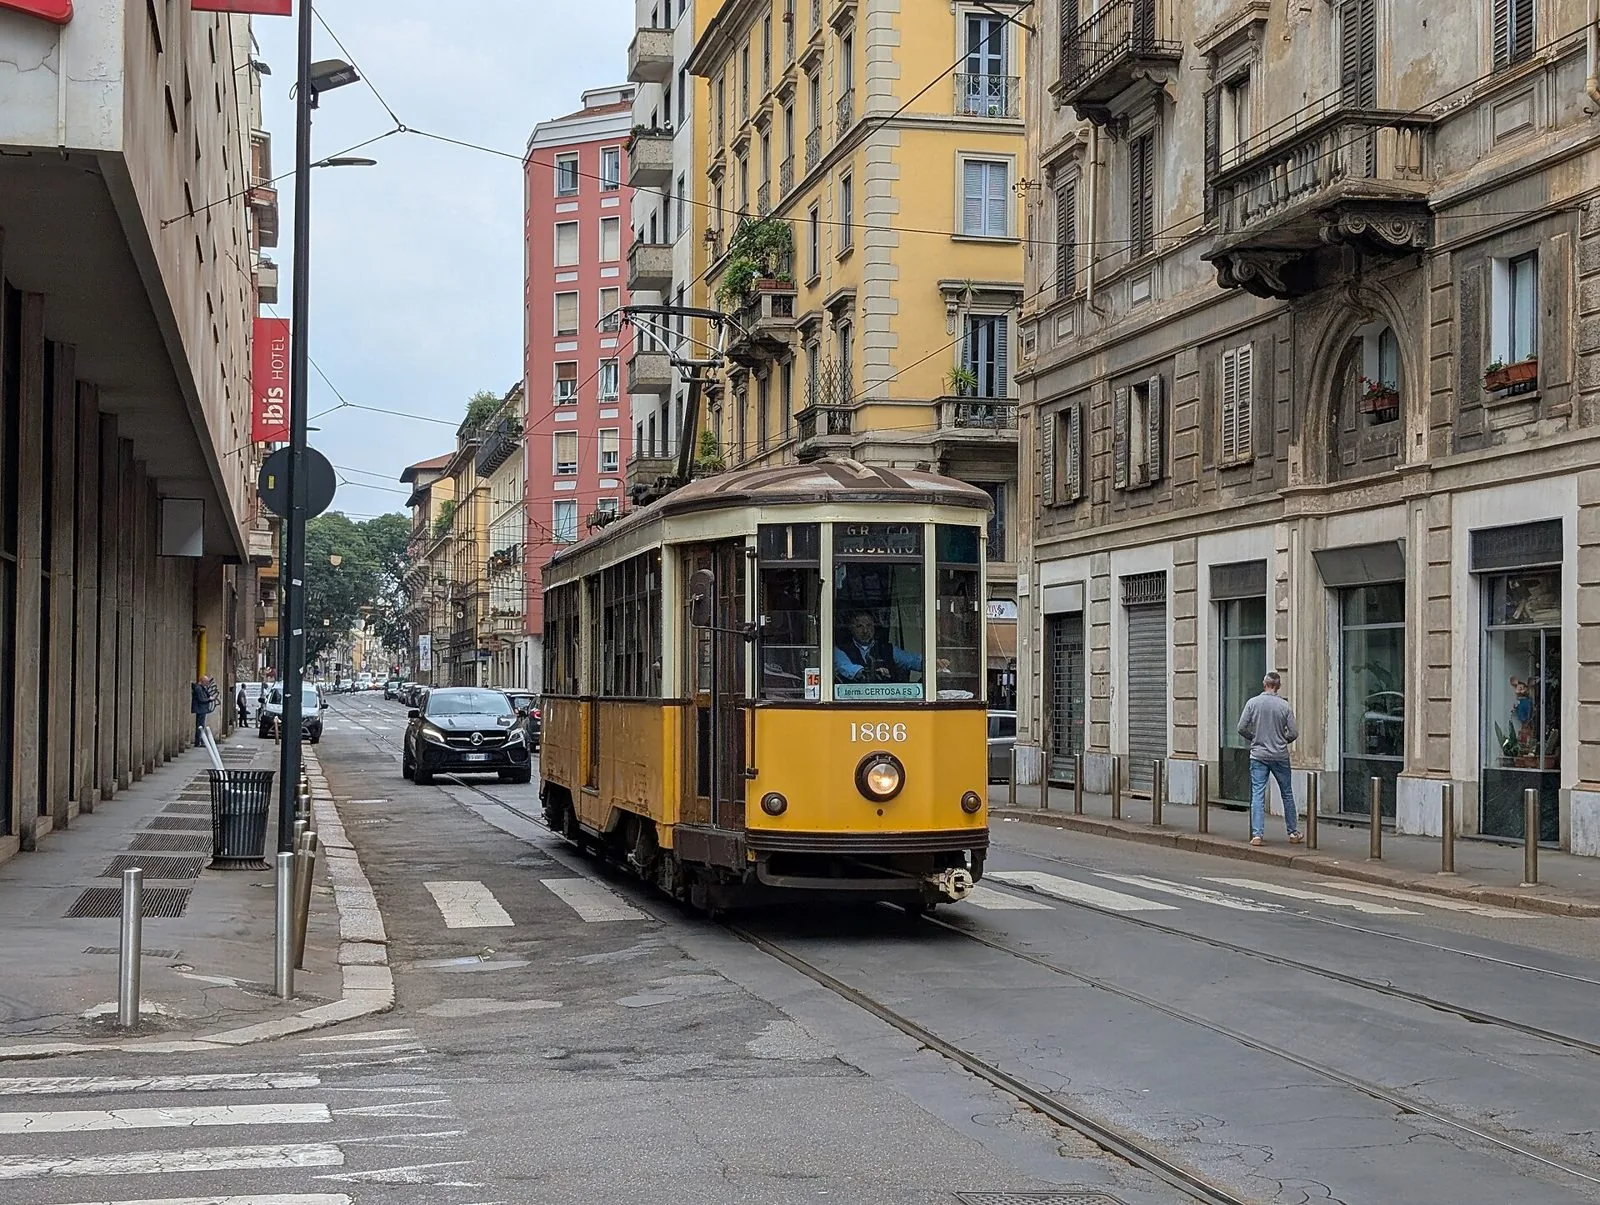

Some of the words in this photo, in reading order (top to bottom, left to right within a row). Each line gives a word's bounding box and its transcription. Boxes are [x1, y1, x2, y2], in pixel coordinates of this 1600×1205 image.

[271, 336, 285, 380] HOTEL
[262, 387, 284, 425] ibis
[864, 687, 902, 696] CERTOSA
[850, 722, 908, 742] 1866
